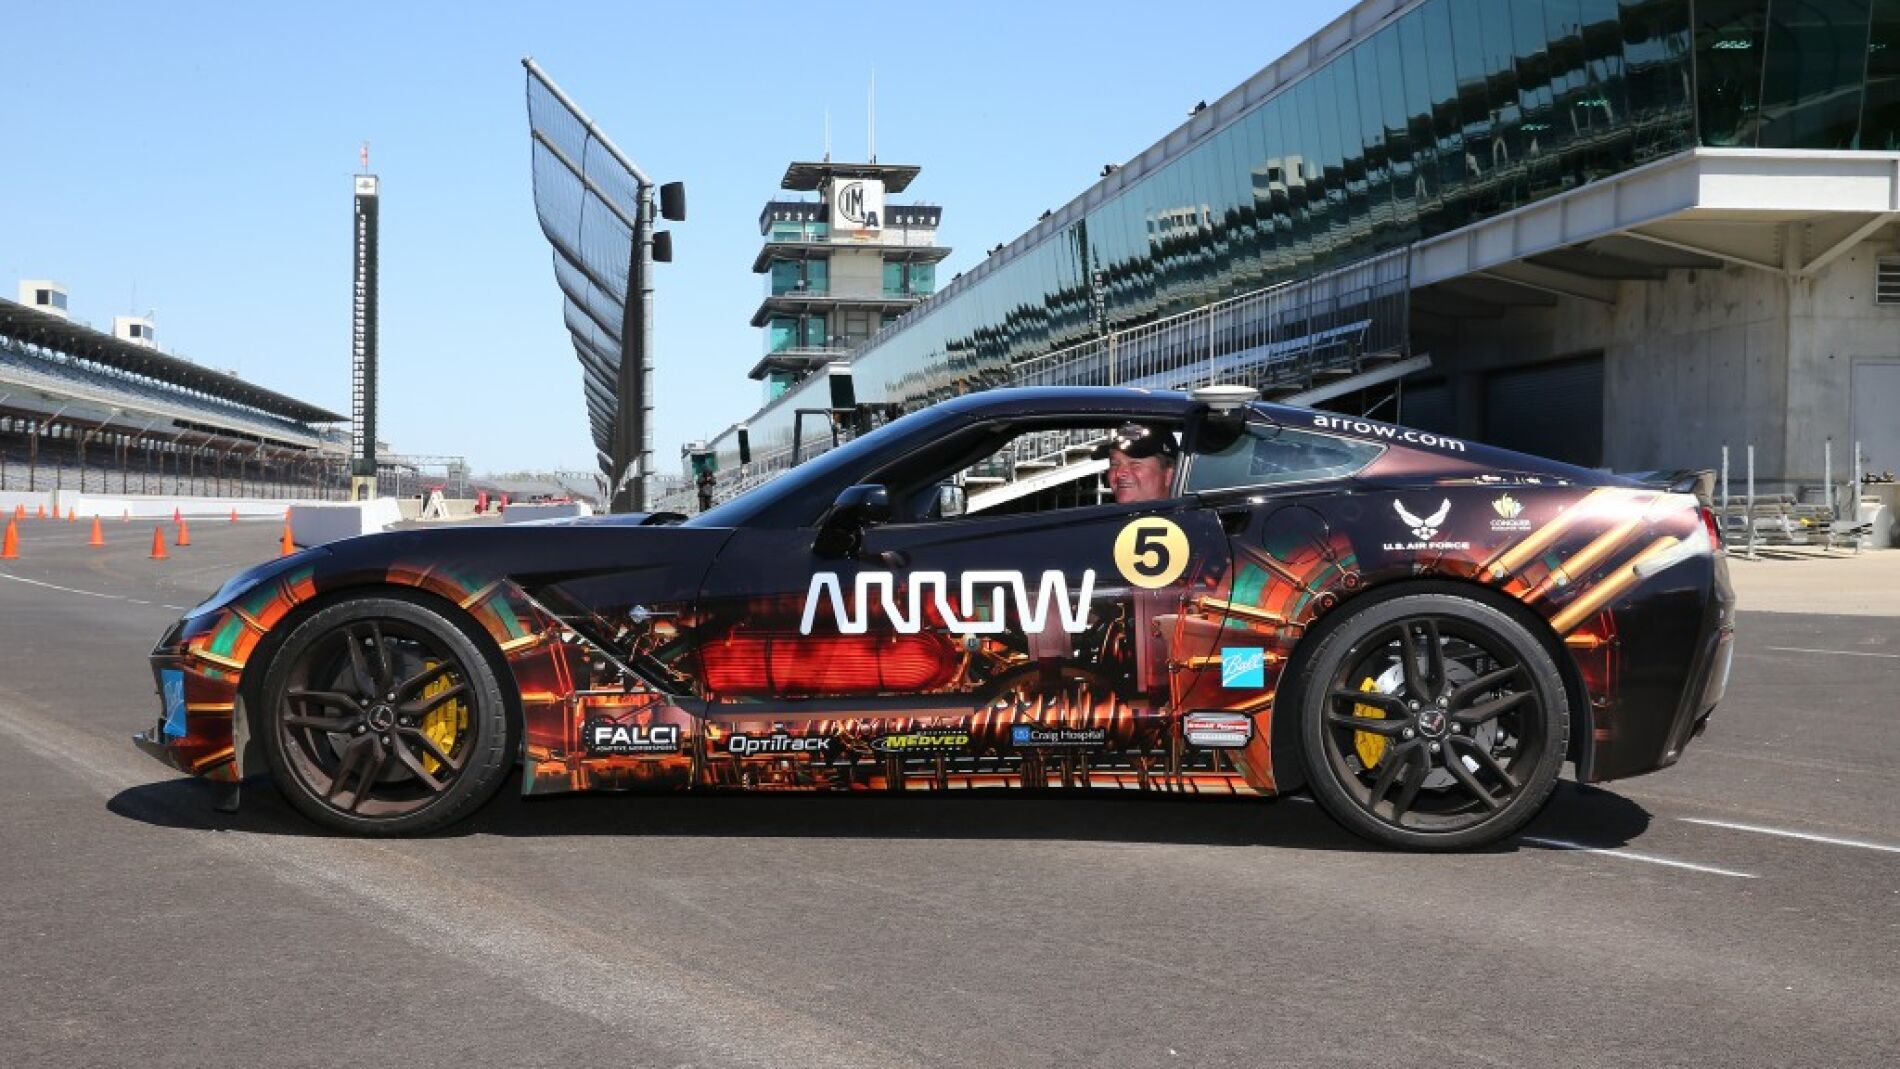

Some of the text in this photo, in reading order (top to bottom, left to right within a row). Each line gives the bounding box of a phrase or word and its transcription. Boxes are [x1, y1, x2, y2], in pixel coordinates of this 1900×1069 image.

[1313, 415, 1465, 451] arrow.com
[1133, 527, 1170, 577] 5
[1406, 541, 1428, 550] AIR
[1428, 541, 1471, 550] FORCE
[801, 569, 1096, 635] ARROW
[594, 726, 678, 745] FALCI
[886, 735, 969, 748] MEDVED
[1031, 728, 1105, 742] Craig Hospital
